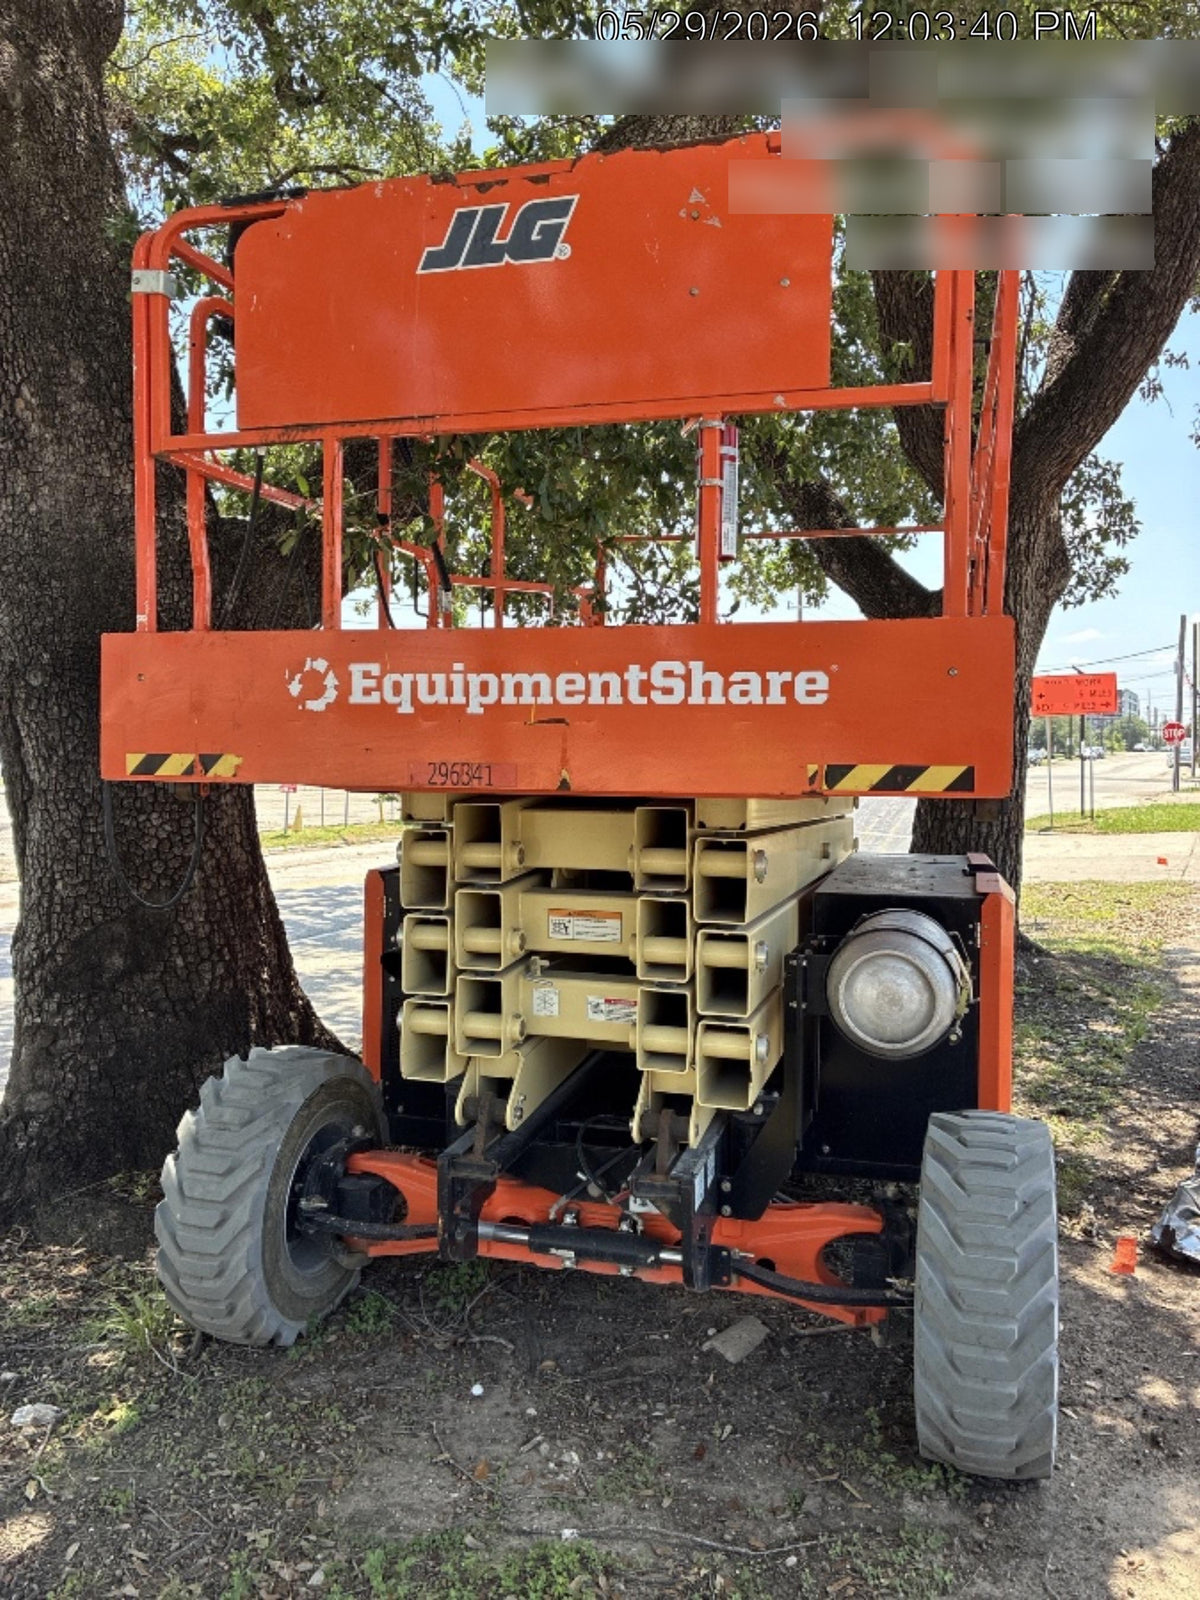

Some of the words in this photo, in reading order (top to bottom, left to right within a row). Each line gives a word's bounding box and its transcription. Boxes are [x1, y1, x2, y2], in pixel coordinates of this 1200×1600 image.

[416, 194, 580, 274] JLG
[348, 660, 830, 714] EquipmentShare
[1164, 727, 1185, 739] STOP
[427, 761, 493, 787] 296341
